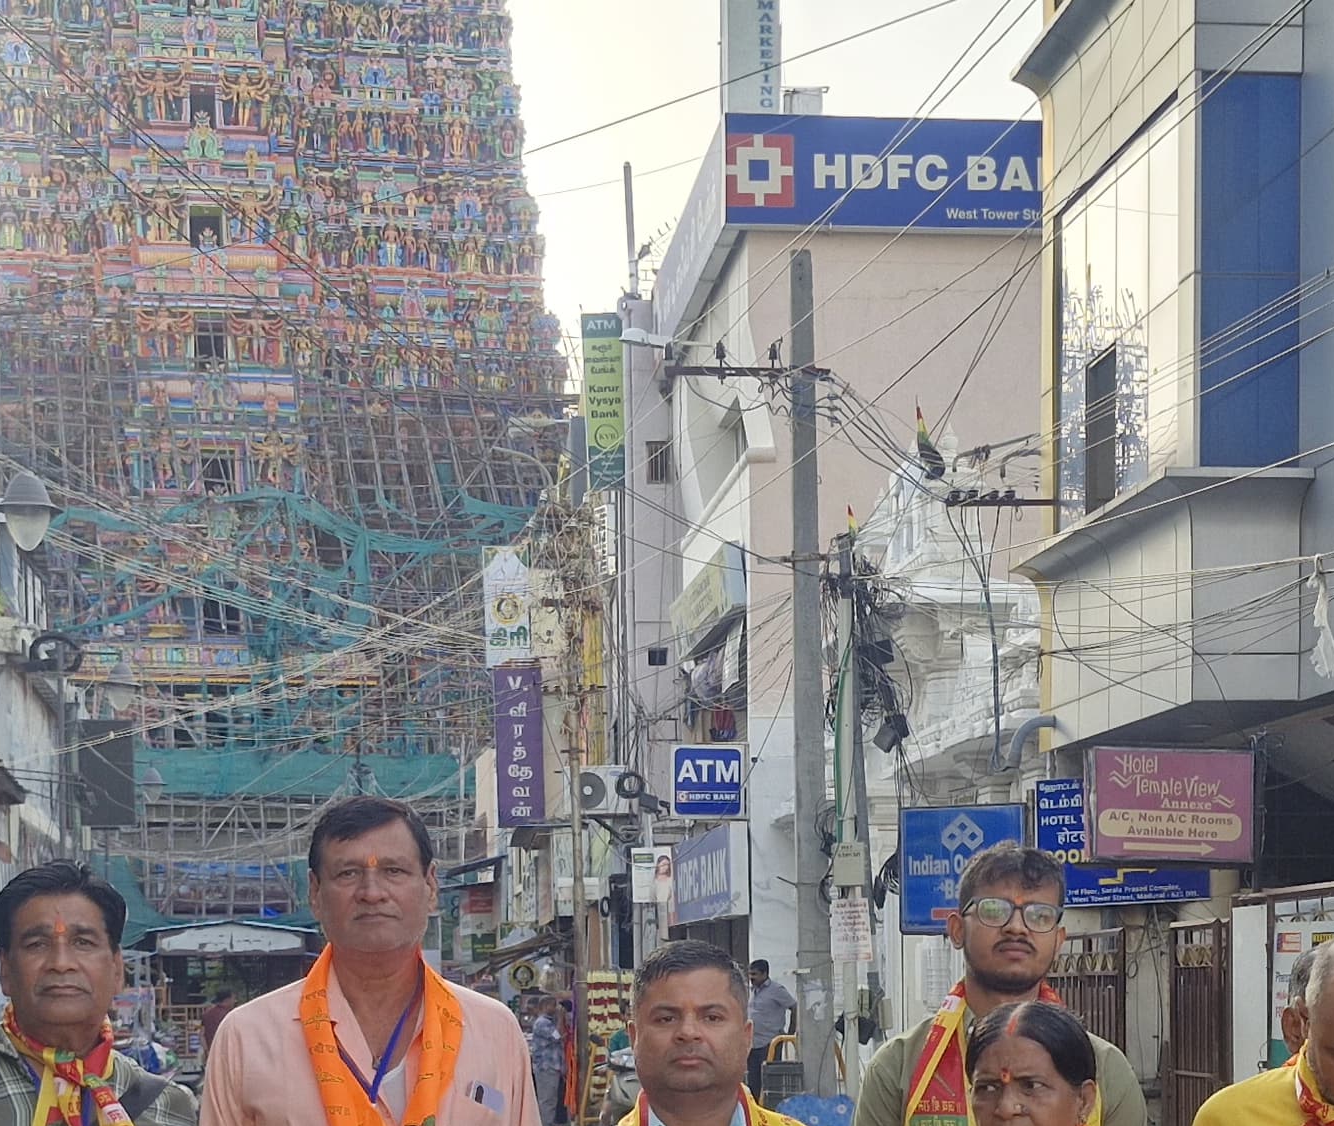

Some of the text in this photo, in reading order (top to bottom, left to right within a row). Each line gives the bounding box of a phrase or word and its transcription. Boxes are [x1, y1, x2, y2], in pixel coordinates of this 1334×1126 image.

[813, 153, 1043, 191] HDFC BA
[946, 208, 1020, 221] West Tower
[586, 320, 616, 330] ATM
[589, 385, 619, 393] Karur
[589, 397, 621, 405] Vysya
[591, 410, 619, 418] Bank
[1118, 753, 1158, 775] Hotel
[677, 759, 739, 783] ATM
[1131, 775, 1220, 799] Temple View
[713, 793, 736, 801] BANK
[1161, 799, 1212, 810] Annexe
[1041, 815, 1076, 826] HOTEL
[1109, 811, 1233, 826] A/C, Non A/C Rooms
[1127, 825, 1217, 838] Available Here
[908, 854, 949, 876] Indian
[677, 848, 727, 904] HDFC BANK
